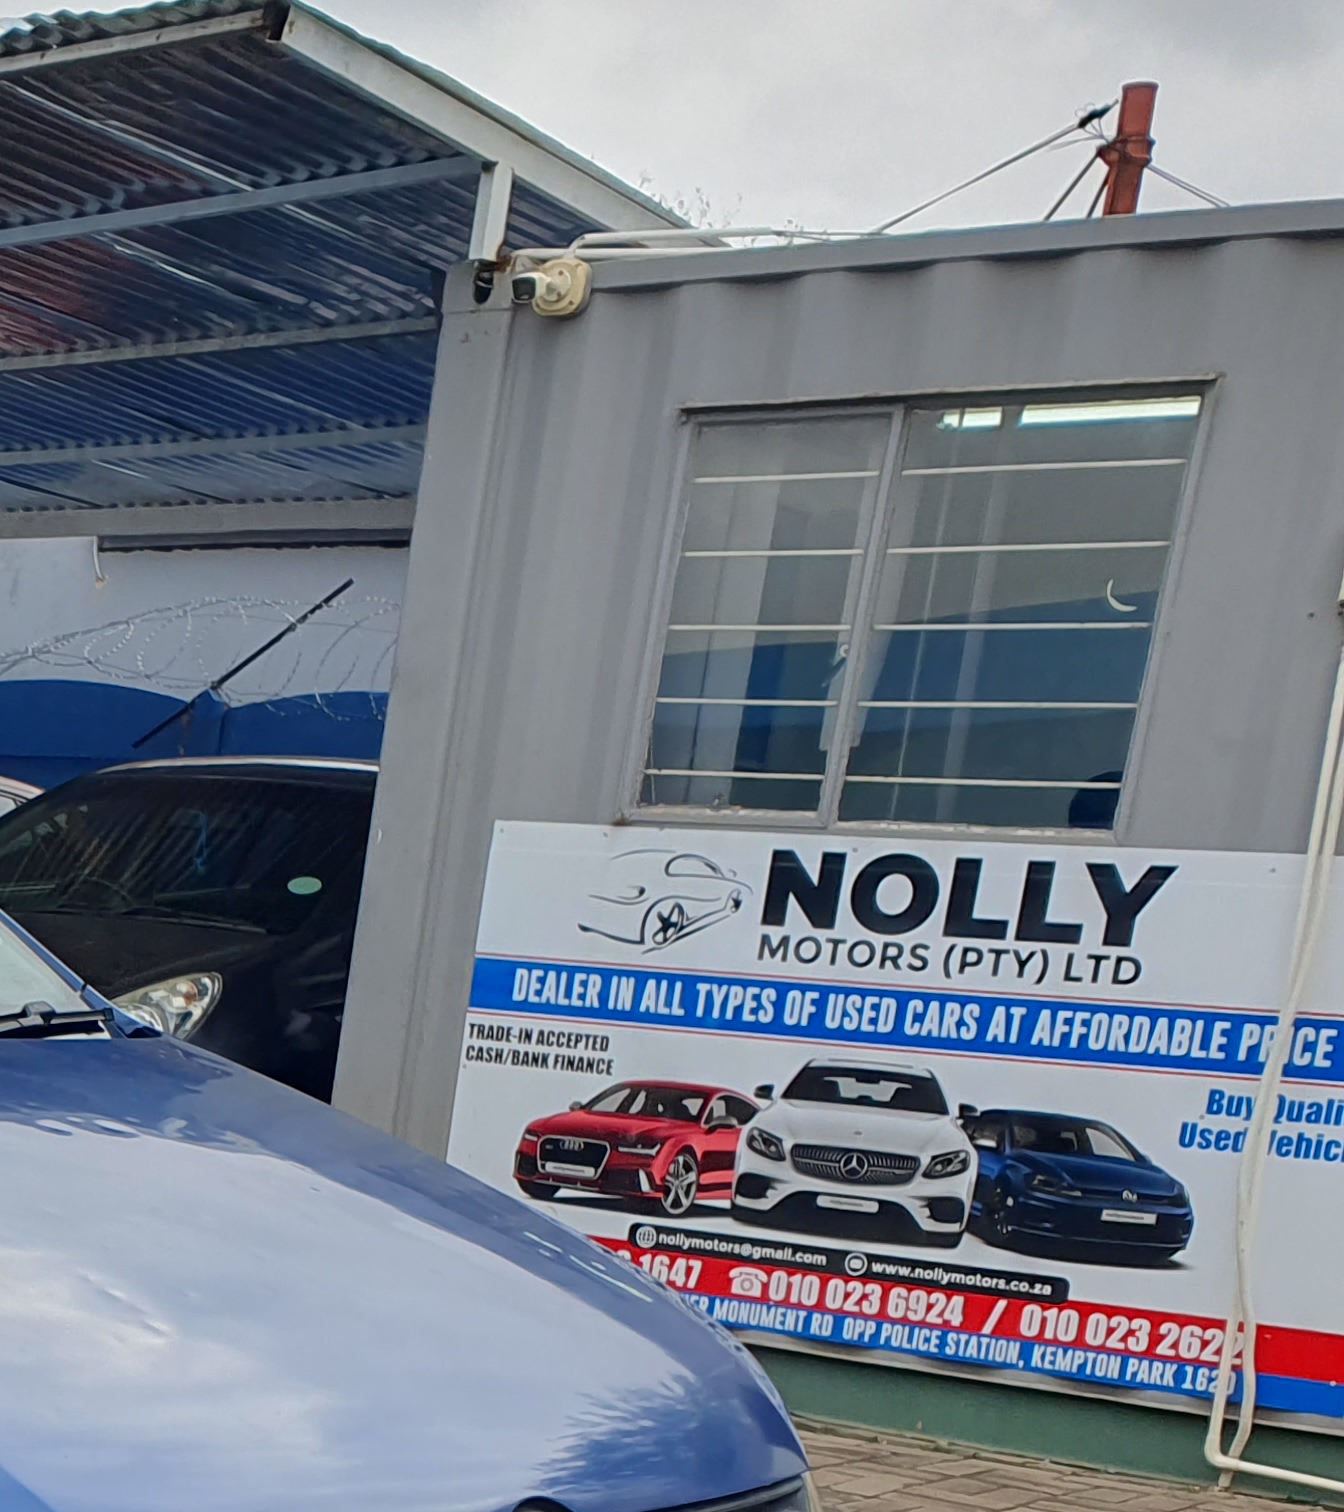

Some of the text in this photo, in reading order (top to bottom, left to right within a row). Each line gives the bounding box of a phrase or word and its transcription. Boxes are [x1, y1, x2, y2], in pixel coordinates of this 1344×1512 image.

[761, 849, 1179, 947] NOLLY
[757, 934, 1142, 984] MOTORS (PTY) LTD
[469, 1023, 609, 1052] TRADE-IN ACCEPTED
[512, 968, 602, 1008] DEALER
[608, 976, 635, 1011] IN
[639, 979, 685, 1016] ALL
[695, 983, 777, 1023] TYPES
[784, 990, 820, 1026] OF
[825, 993, 897, 1033] USED
[904, 999, 980, 1040] CARS
[986, 1006, 1027, 1043] AT
[1031, 1009, 1231, 1059] AFFORDABLE
[465, 1045, 614, 1076] CASH/BANK FINANCE
[659, 1231, 1052, 1296] nollymotors@gmail.com www.nollymotors.co.za
[713, 1298, 807, 1334] MONUMENT
[810, 1316, 834, 1337] RD
[842, 1318, 875, 1343] OPP
[879, 1324, 941, 1352] POLICE
[946, 1331, 1024, 1369] STATION,
[1032, 1345, 1122, 1381] KEMPTON
[1126, 1358, 1177, 1388] PARK
[769, 1270, 820, 1306] 010
[825, 1277, 882, 1315] 023
[887, 1286, 965, 1326] 6924
[1019, 1304, 1079, 1342] 010
[1084, 1312, 1151, 1352] 023
